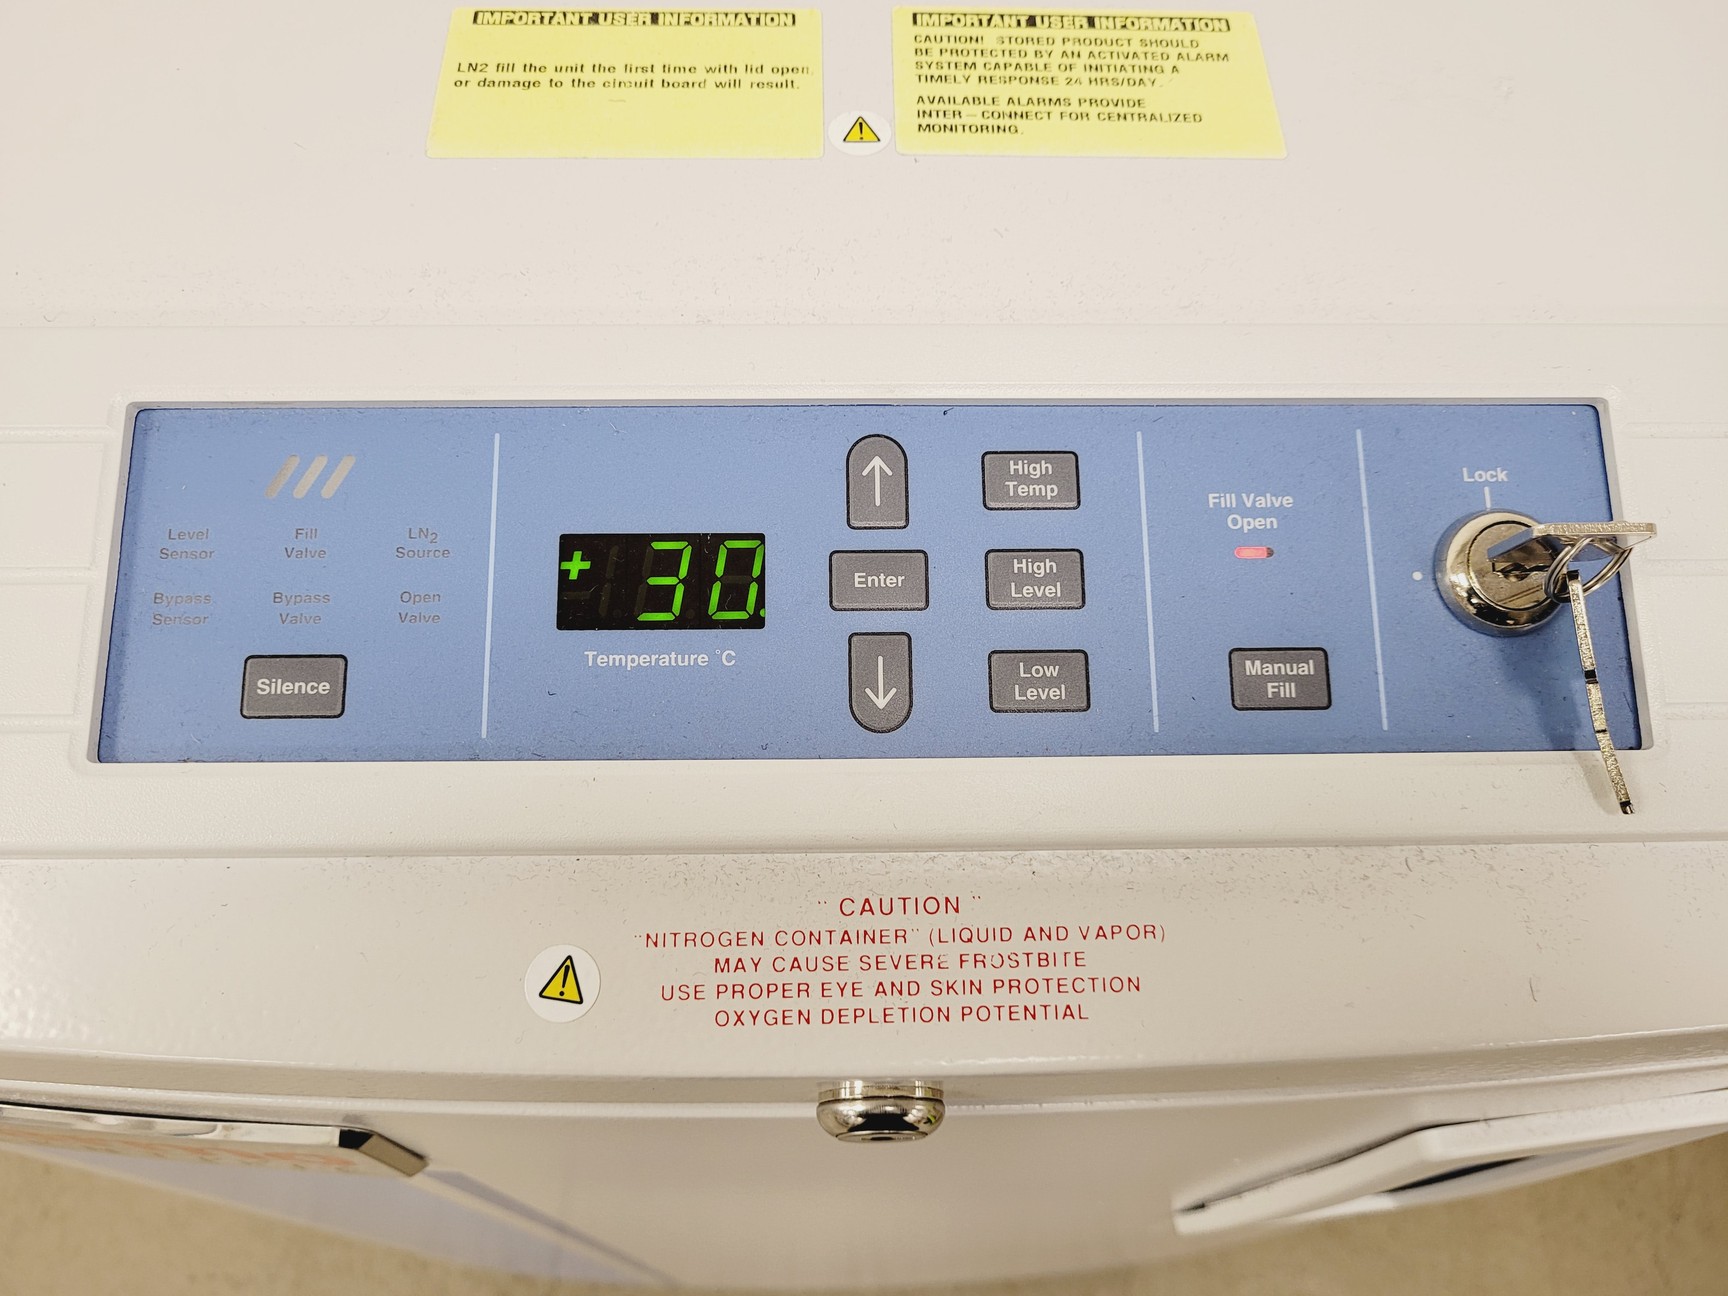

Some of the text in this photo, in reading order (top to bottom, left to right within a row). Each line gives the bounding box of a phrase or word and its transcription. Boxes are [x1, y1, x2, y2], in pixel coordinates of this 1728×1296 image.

[474, 11, 795, 27] IMPORTANT USER INFORMATION
[914, 13, 1230, 32] IMPORTANT USER INFORMATION
[914, 35, 1200, 48] CAUTION! STORED PRODUCT SHOULD
[915, 48, 1229, 62] BE PROTECTED BY AN ACTIVATED ALARM
[457, 62, 489, 73] LN2
[496, 62, 515, 73] fill
[523, 63, 547, 73] the
[554, 63, 585, 73] unit
[592, 63, 616, 73] the
[624, 64, 655, 74] first
[662, 64, 697, 74] time
[704, 64, 738, 74] with
[745, 64, 764, 74] lid
[915, 61, 1180, 74] SYSTEM CAPABLE OF INITIATING A
[454, 79, 471, 88] or
[477, 78, 541, 90] damage
[549, 78, 563, 88] to
[571, 78, 596, 88] the
[661, 79, 707, 89] board
[714, 79, 741, 89] will
[750, 79, 800, 89] result.
[916, 75, 971, 84] TIMELY
[978, 76, 1060, 85] RESPONSE
[917, 96, 1146, 108] AVAILABLE ALARMS PROVIDE
[917, 109, 962, 119] INTER
[982, 110, 1053, 120] CONNECT
[1060, 112, 1090, 122] FOR
[1097, 112, 1203, 123] CENTRALIZED
[917, 124, 1024, 134] MONITORING.
[1008, 460, 1053, 479] High
[1462, 467, 1509, 483] Lock
[1005, 481, 1059, 500] Temp
[1208, 493, 1294, 509] Fill Valve
[1227, 514, 1278, 532] Open
[168, 527, 209, 541] Level
[294, 527, 318, 540] Fill
[159, 547, 215, 560] Sensor
[284, 546, 327, 559] Valve
[395, 546, 451, 559] Source
[1013, 558, 1057, 577] High
[853, 572, 905, 588] Enter
[1011, 580, 1062, 598] Level
[153, 592, 212, 607] Bypass
[272, 591, 331, 606] Bypass
[399, 591, 441, 605] Open
[151, 613, 209, 626] Sensor
[279, 612, 322, 625] Valve
[398, 611, 441, 624] Valve
[584, 649, 736, 670] Temperature °C
[1244, 659, 1315, 676] Manual
[1019, 662, 1060, 679] Low
[256, 678, 331, 695] Silence
[1014, 684, 1067, 701] Level
[1267, 682, 1296, 699] Fill
[839, 896, 960, 916] CAUTION
[929, 926, 1013, 946] (LIQUID
[1023, 925, 1069, 942] AND
[1078, 924, 1166, 943] VAPOR)
[714, 951, 1087, 973] MAY CAUSE SEVERE FROSTBITE
[661, 976, 1141, 1001] USE PROPER EYE AND SKIN PROTECTION
[714, 1004, 1089, 1027] OXYGEN DEPLETION POTENTIAL
